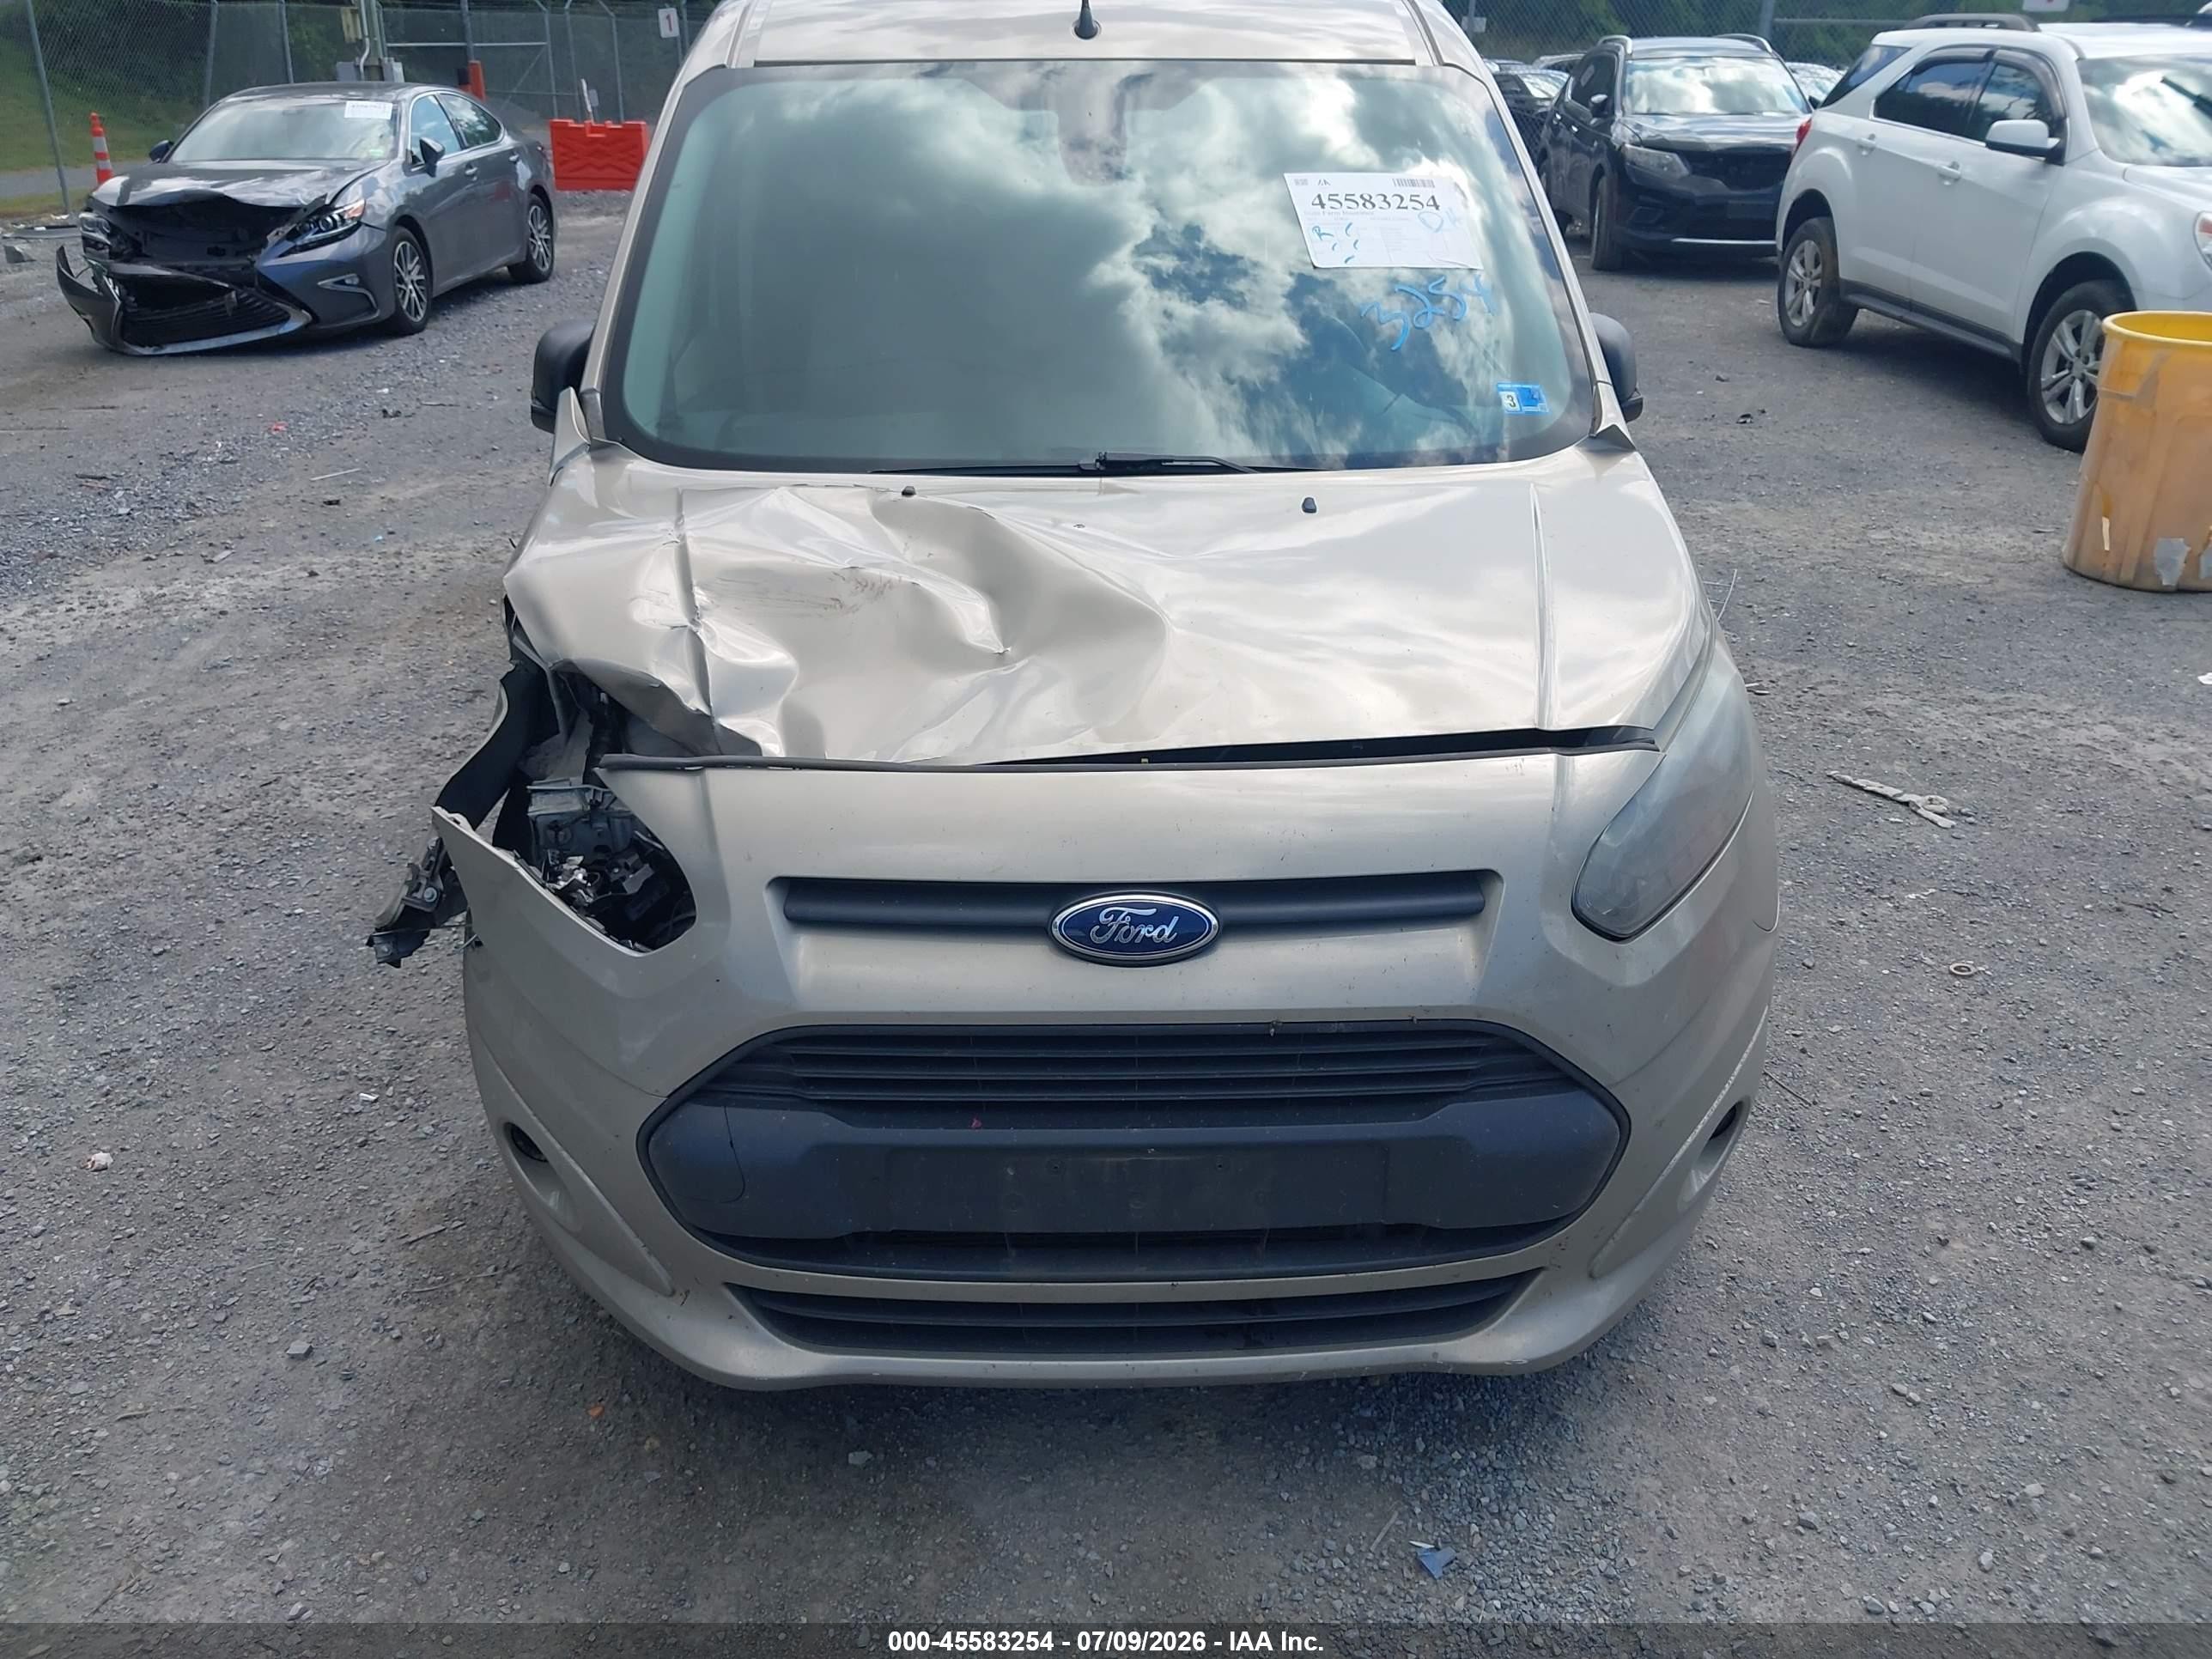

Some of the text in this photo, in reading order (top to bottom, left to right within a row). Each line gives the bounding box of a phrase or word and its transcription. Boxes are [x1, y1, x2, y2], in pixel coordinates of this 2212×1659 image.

[665, 13, 673, 33] 1
[1310, 192, 1442, 211] 45583254
[1360, 274, 1498, 352] 3254
[1505, 393, 1517, 408] 3
[1089, 906, 1180, 945] Ford
